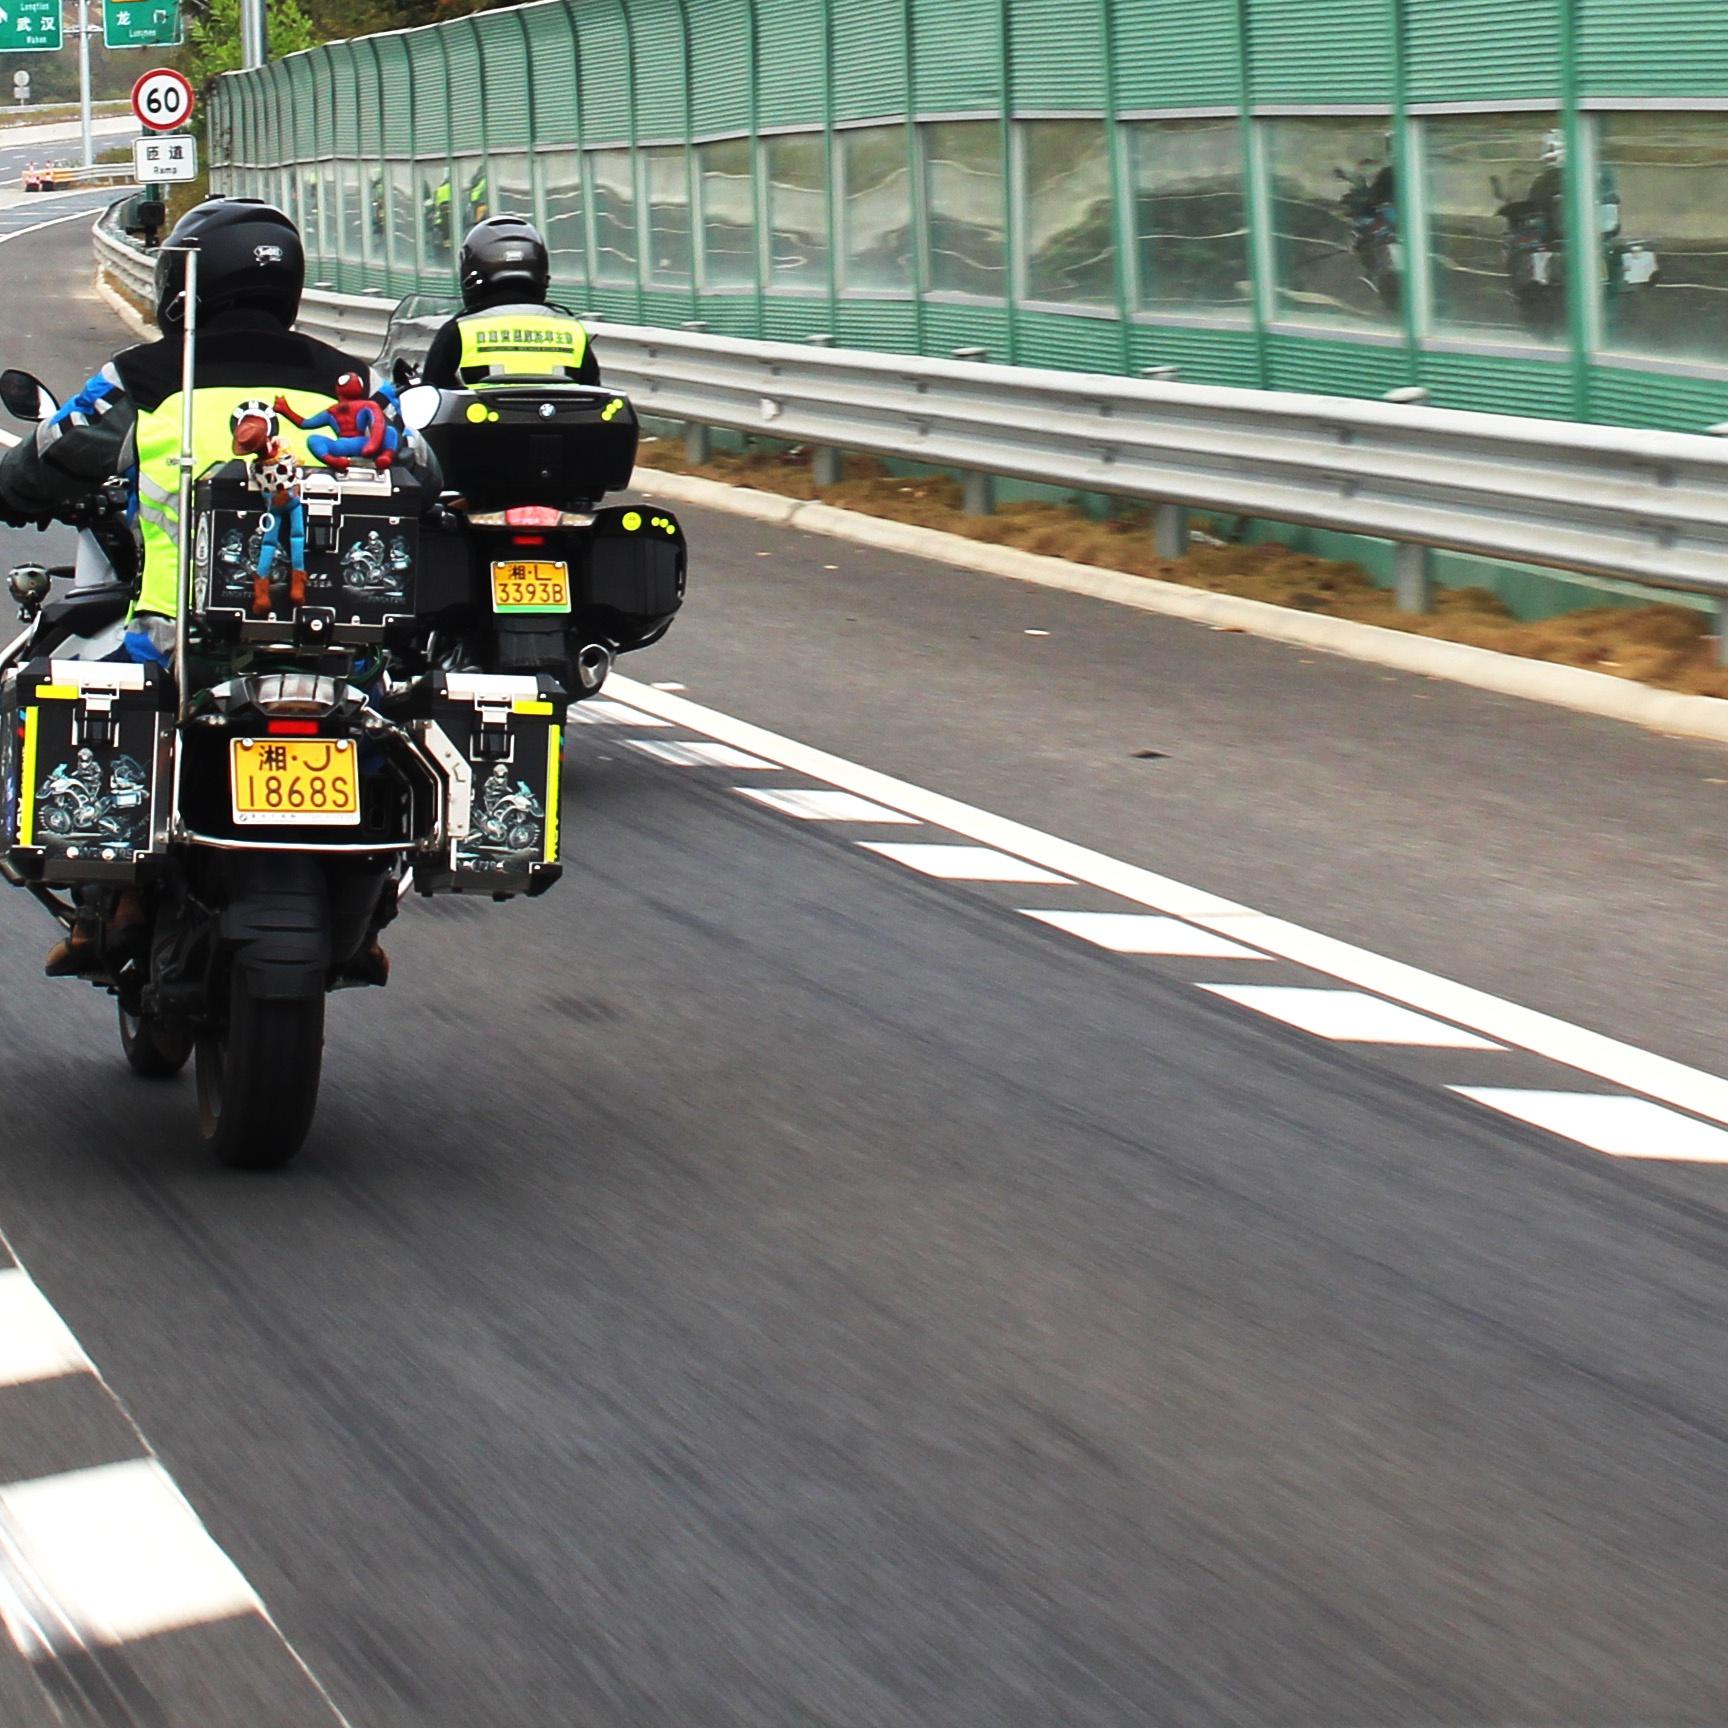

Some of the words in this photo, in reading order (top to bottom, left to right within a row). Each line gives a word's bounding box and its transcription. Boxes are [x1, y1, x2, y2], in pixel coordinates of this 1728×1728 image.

[16, 16, 56, 32] 武汉
[146, 86, 180, 113] 60
[146, 145, 184, 161] 匝道
[498, 582, 564, 603] 3393B
[248, 775, 350, 808] 1868S
